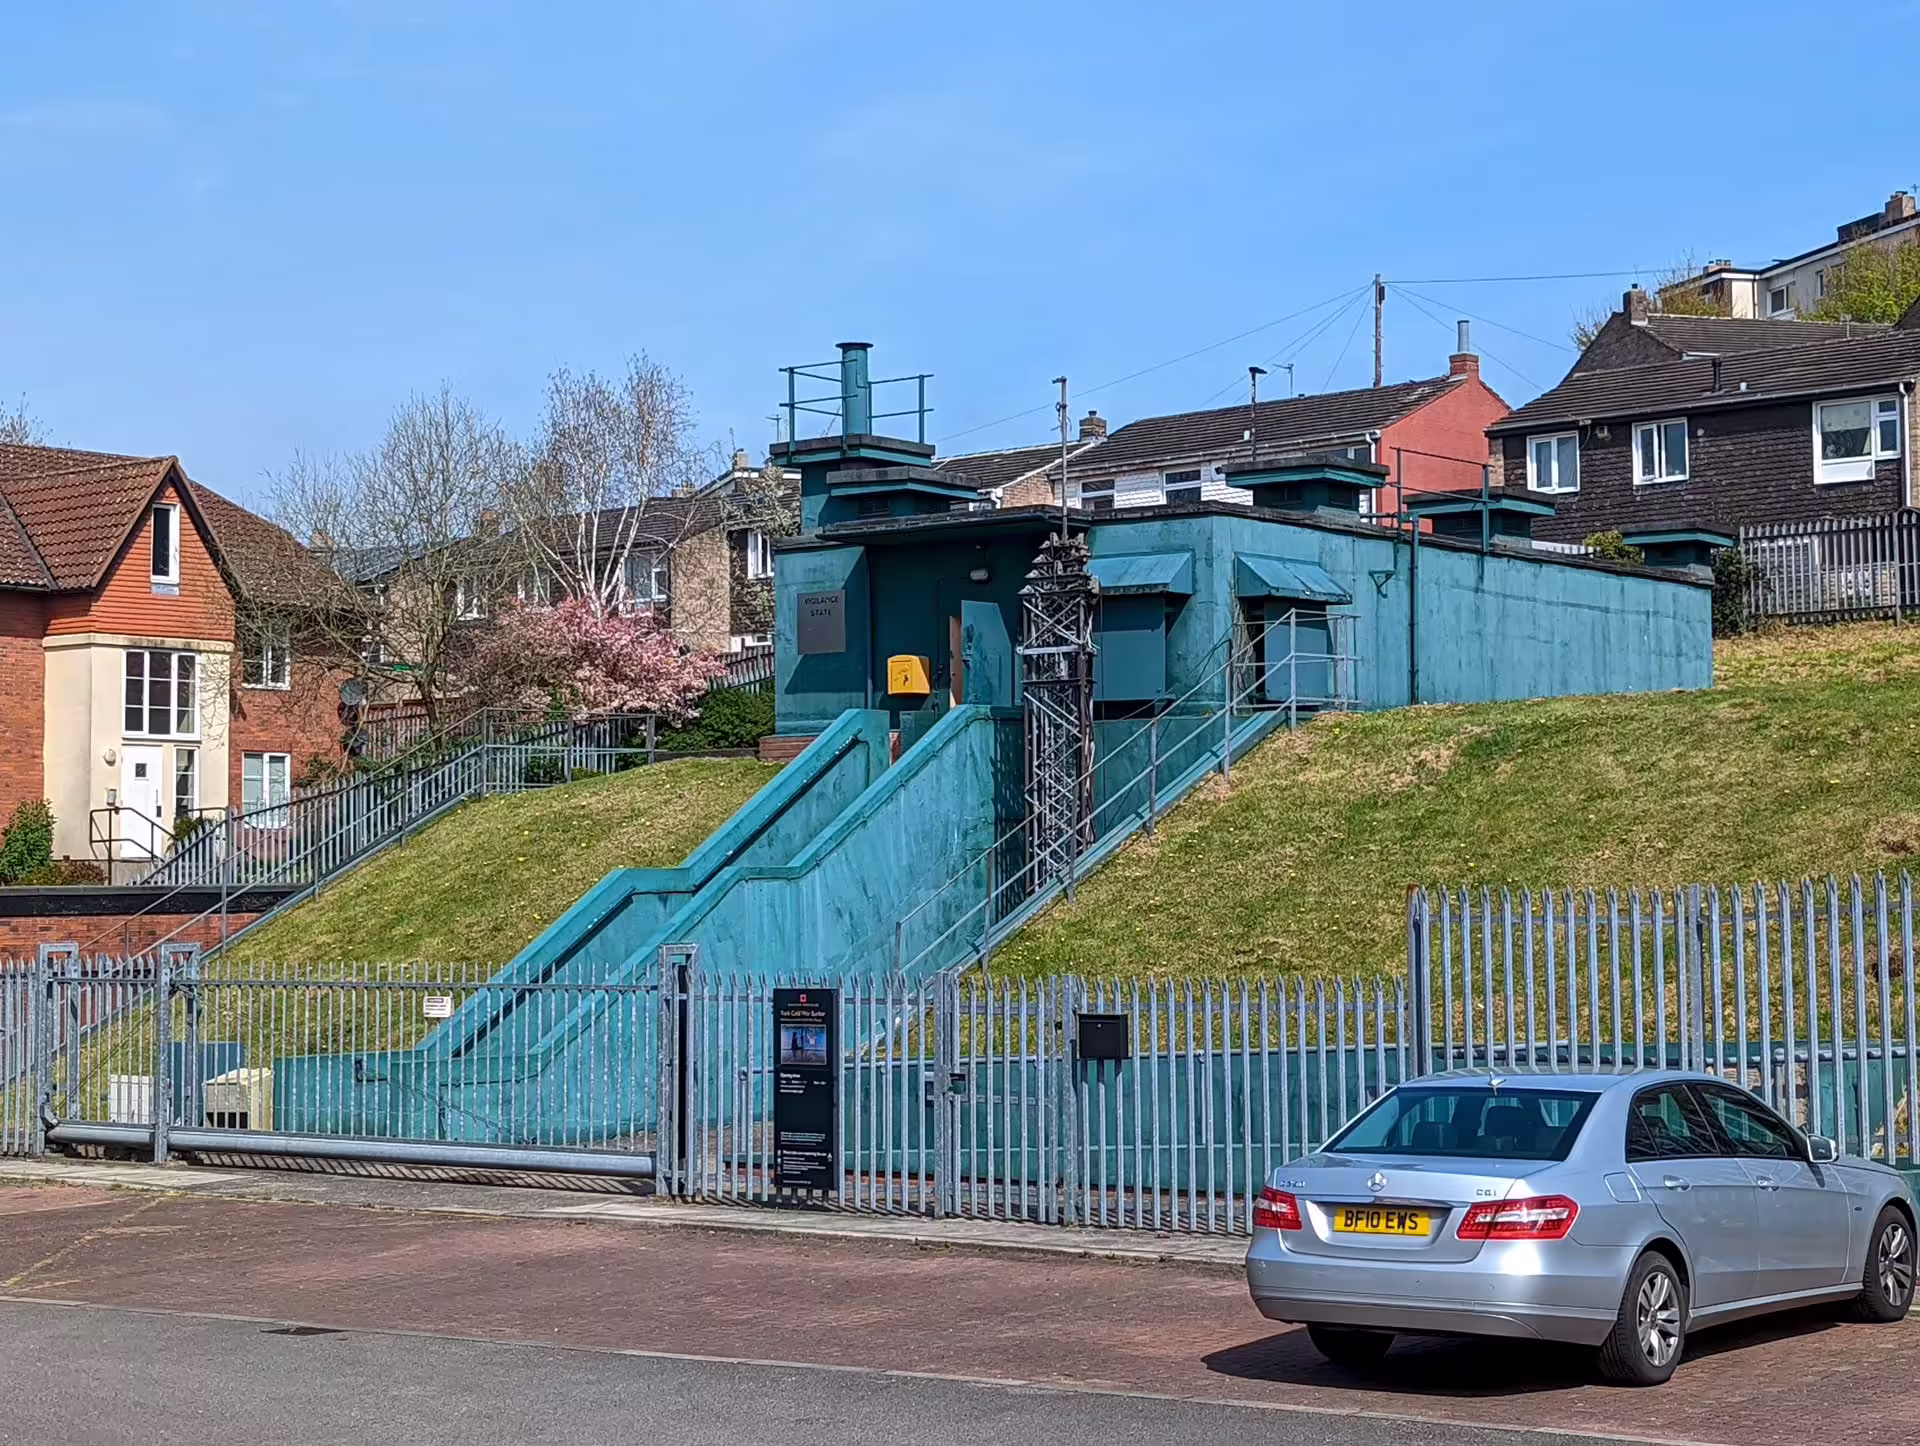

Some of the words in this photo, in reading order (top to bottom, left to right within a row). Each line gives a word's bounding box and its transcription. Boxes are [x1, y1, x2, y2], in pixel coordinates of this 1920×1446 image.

[810, 608, 831, 616] STATE
[1344, 1209, 1380, 1229] BF10
[1385, 1211, 1419, 1231] EWS
